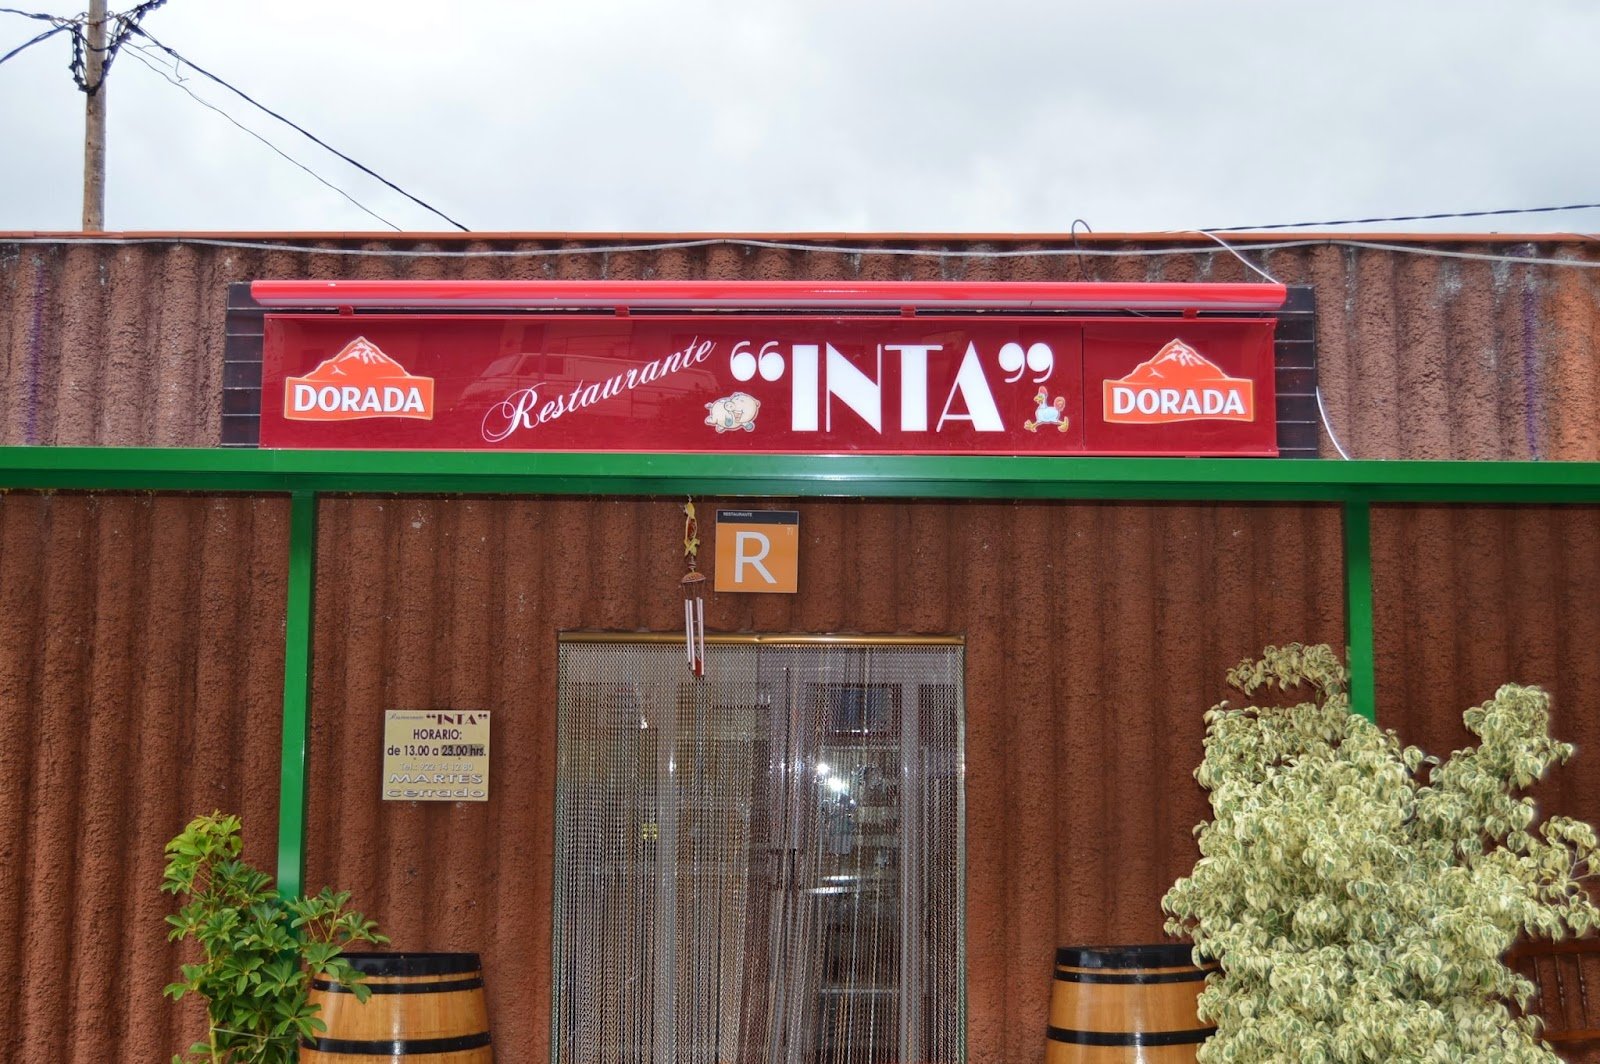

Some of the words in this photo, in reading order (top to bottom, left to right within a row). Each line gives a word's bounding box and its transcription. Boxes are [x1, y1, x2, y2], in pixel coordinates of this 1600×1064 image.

[294, 384, 425, 412] DORADA
[481, 335, 717, 443] Restaurante
[1112, 387, 1246, 415] DORADA
[734, 531, 777, 584] R
[413, 729, 462, 740] HORARIO:
[387, 744, 401, 756] de
[404, 744, 430, 756] 13.00
[432, 747, 439, 756] a
[441, 744, 468, 756] 23.00
[470, 744, 487, 757] hrs.
[389, 773, 483, 784] MARTES
[387, 787, 486, 798] cerrado
